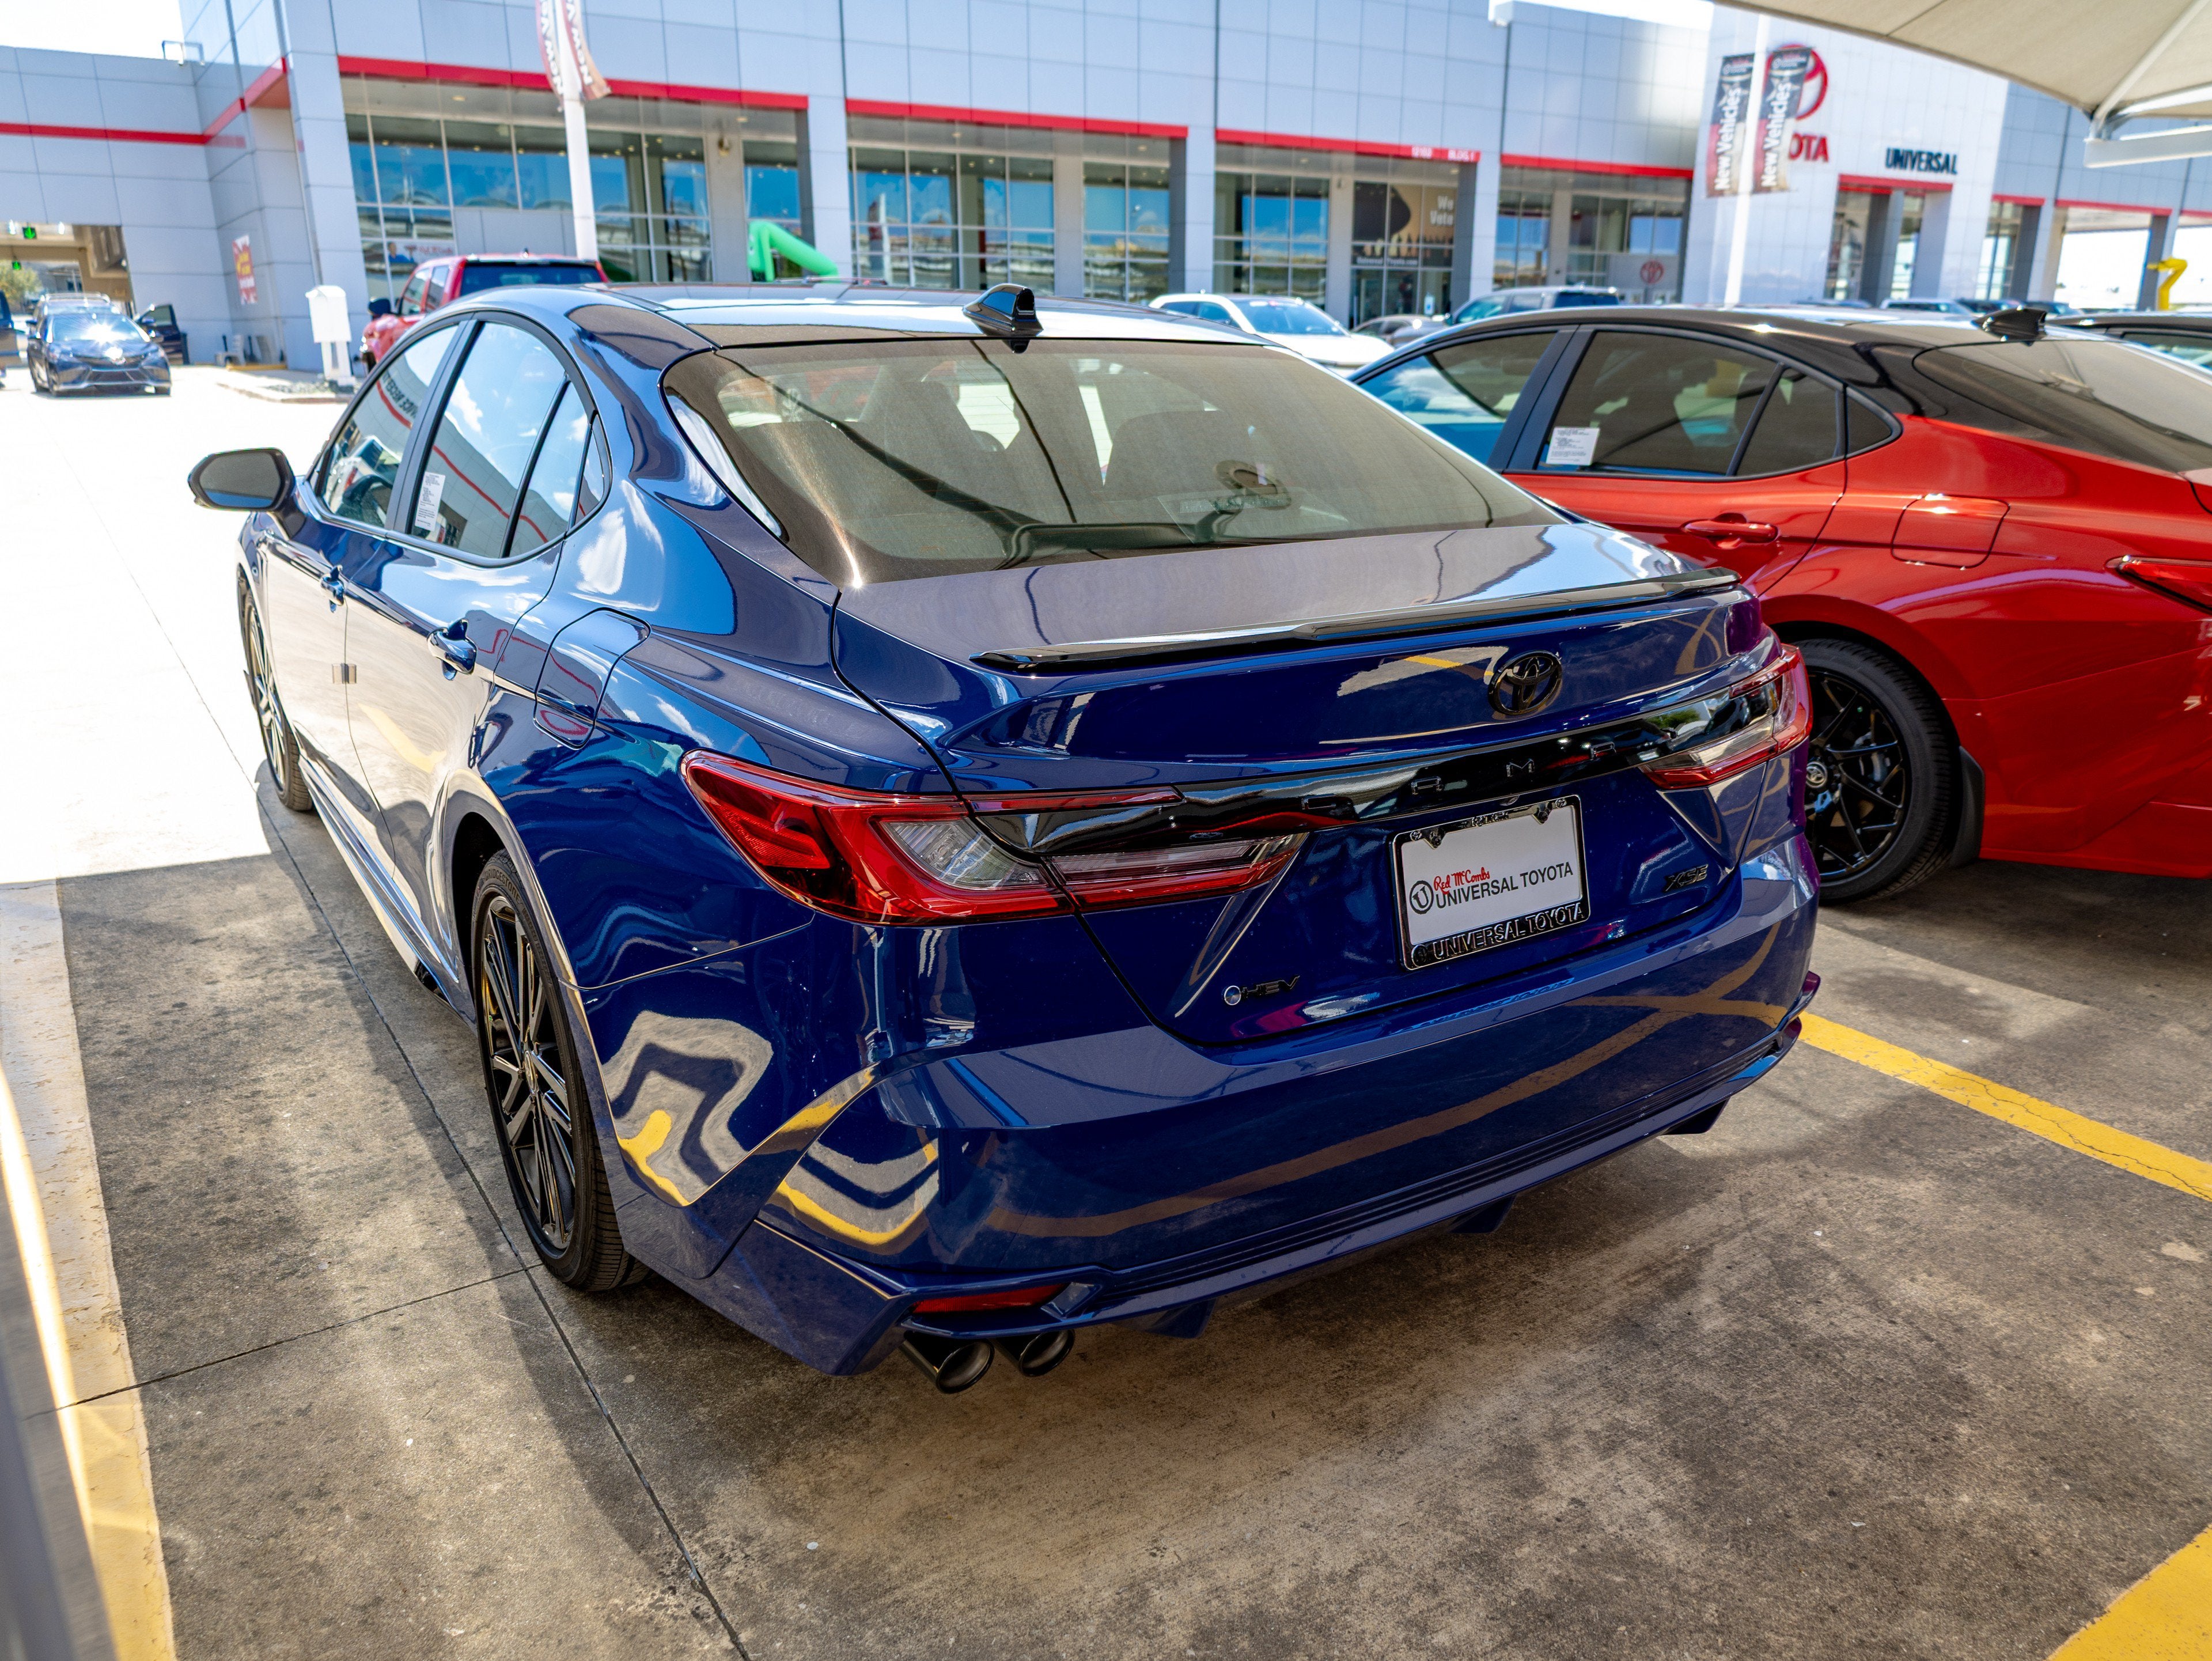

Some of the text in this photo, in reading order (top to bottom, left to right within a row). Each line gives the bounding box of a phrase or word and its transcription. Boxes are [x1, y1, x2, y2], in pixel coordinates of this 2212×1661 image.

[571, 27, 593, 86] New
[1715, 86, 1743, 155] Vehicles
[1762, 81, 1792, 151] Vehicles
[1788, 131, 1830, 162] OTA
[1885, 147, 1957, 175] UNIVERSAL
[1714, 154, 1731, 191] New
[1760, 152, 1778, 187] New
[1433, 867, 1490, 895] Red McCombs
[1435, 861, 1573, 909] UNIVERSAL TOYOTA
[1433, 902, 1585, 960] UNIVERSAL TOYOTA
